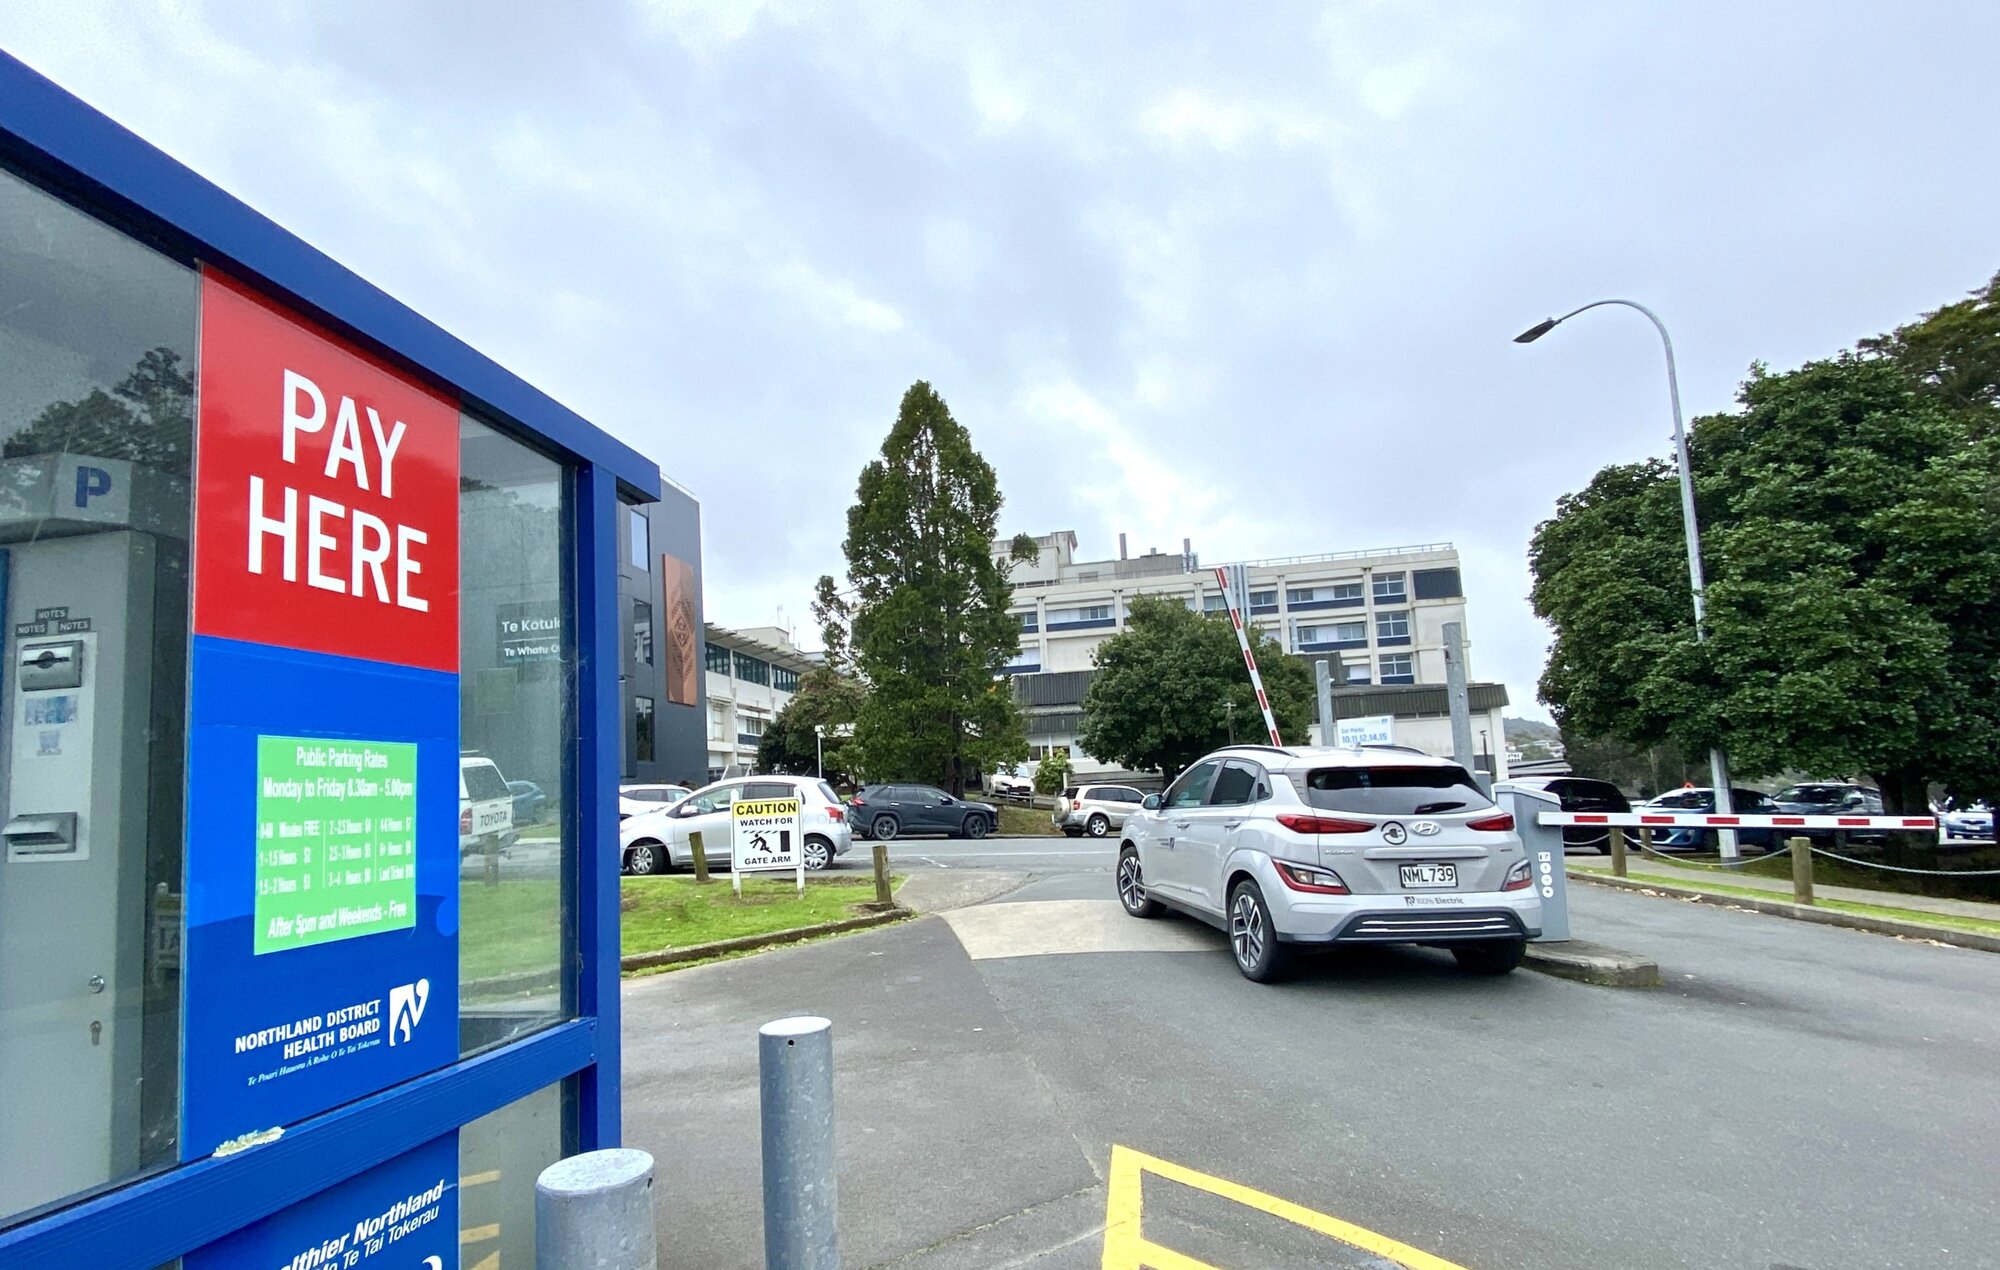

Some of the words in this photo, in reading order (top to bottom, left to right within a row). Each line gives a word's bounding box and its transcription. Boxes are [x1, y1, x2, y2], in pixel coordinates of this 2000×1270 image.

[282, 368, 407, 499] PAY
[75, 466, 111, 508] P
[248, 475, 429, 613] HERE
[38, 609, 66, 619] NOTES
[17, 624, 46, 634] NOTES
[60, 620, 88, 631] NOTES
[502, 621, 518, 633] Te
[504, 647, 515, 657] Te
[517, 645, 548, 656] Whatu
[296, 746, 327, 767] Public
[328, 747, 363, 773] Parking
[364, 749, 388, 769] Rates
[263, 777, 303, 803] Monday
[305, 779, 315, 798] to
[317, 778, 346, 802] Friday
[348, 778, 378, 797] 8.30am
[384, 778, 413, 801] 5.00pm
[480, 811, 507, 827] TOYOTA
[736, 802, 797, 815] CAUTION
[304, 820, 320, 835] FREE
[740, 818, 772, 827] WATCH
[774, 817, 793, 825] FOR
[744, 857, 769, 865] GATE
[771, 855, 791, 863] ARM
[1402, 867, 1454, 882] NML739
[268, 916, 294, 939] After
[295, 914, 317, 939] 5pm
[318, 908, 338, 931] and
[339, 902, 382, 927] Weekends
[389, 900, 407, 919] Free
[235, 1016, 322, 1054] NORTHLAND
[326, 1000, 381, 1028] DISTRICT
[284, 1030, 335, 1060] HEALTH
[340, 1018, 381, 1043] BOARD
[248, 1076, 256, 1086] Te
[258, 1069, 278, 1083] Poari
[331, 1050, 337, 1059] O
[338, 1047, 346, 1057] Te
[353, 1179, 445, 1245] Northland
[343, 1249, 359, 1270] Te
[364, 1233, 385, 1258] Tai
[388, 1206, 440, 1244] Tokerau
